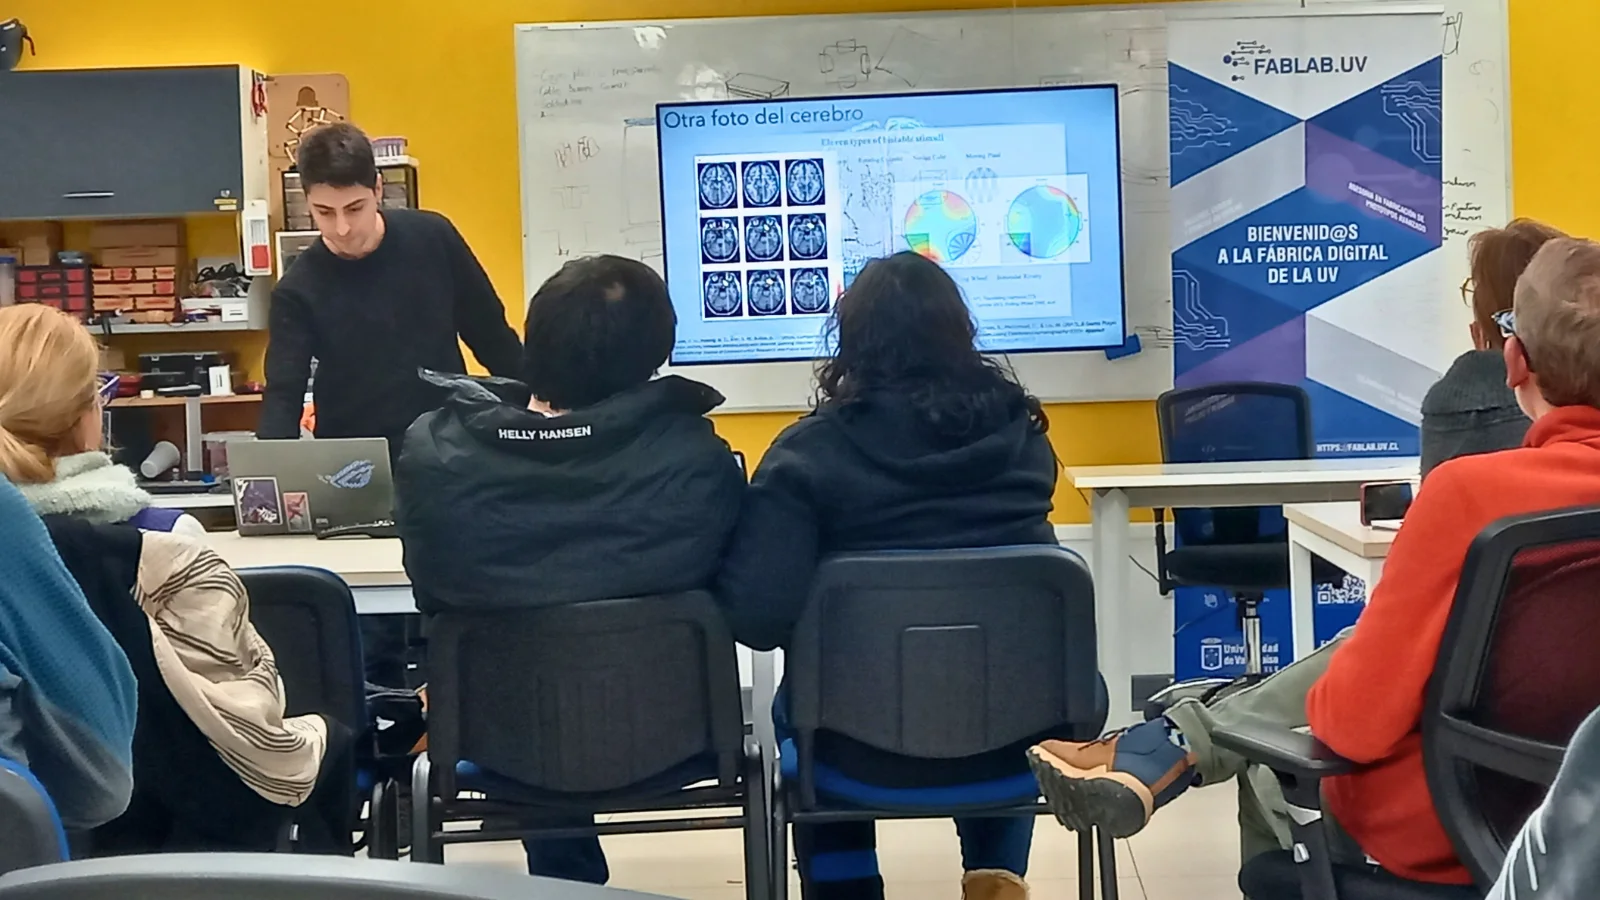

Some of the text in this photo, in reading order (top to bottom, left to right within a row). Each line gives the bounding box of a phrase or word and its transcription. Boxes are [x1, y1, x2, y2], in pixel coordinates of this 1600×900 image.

[1254, 56, 1367, 75] FABLAB.UV
[664, 105, 864, 128] Otra foto del cerebro
[1247, 224, 1359, 243] BIENVENID@S
[1217, 243, 1388, 264] A LA FÁBRICA DIGITAL
[1268, 266, 1339, 284] DE LA UV
[498, 425, 592, 440] HELLY HANSEN
[1224, 655, 1234, 665] de
